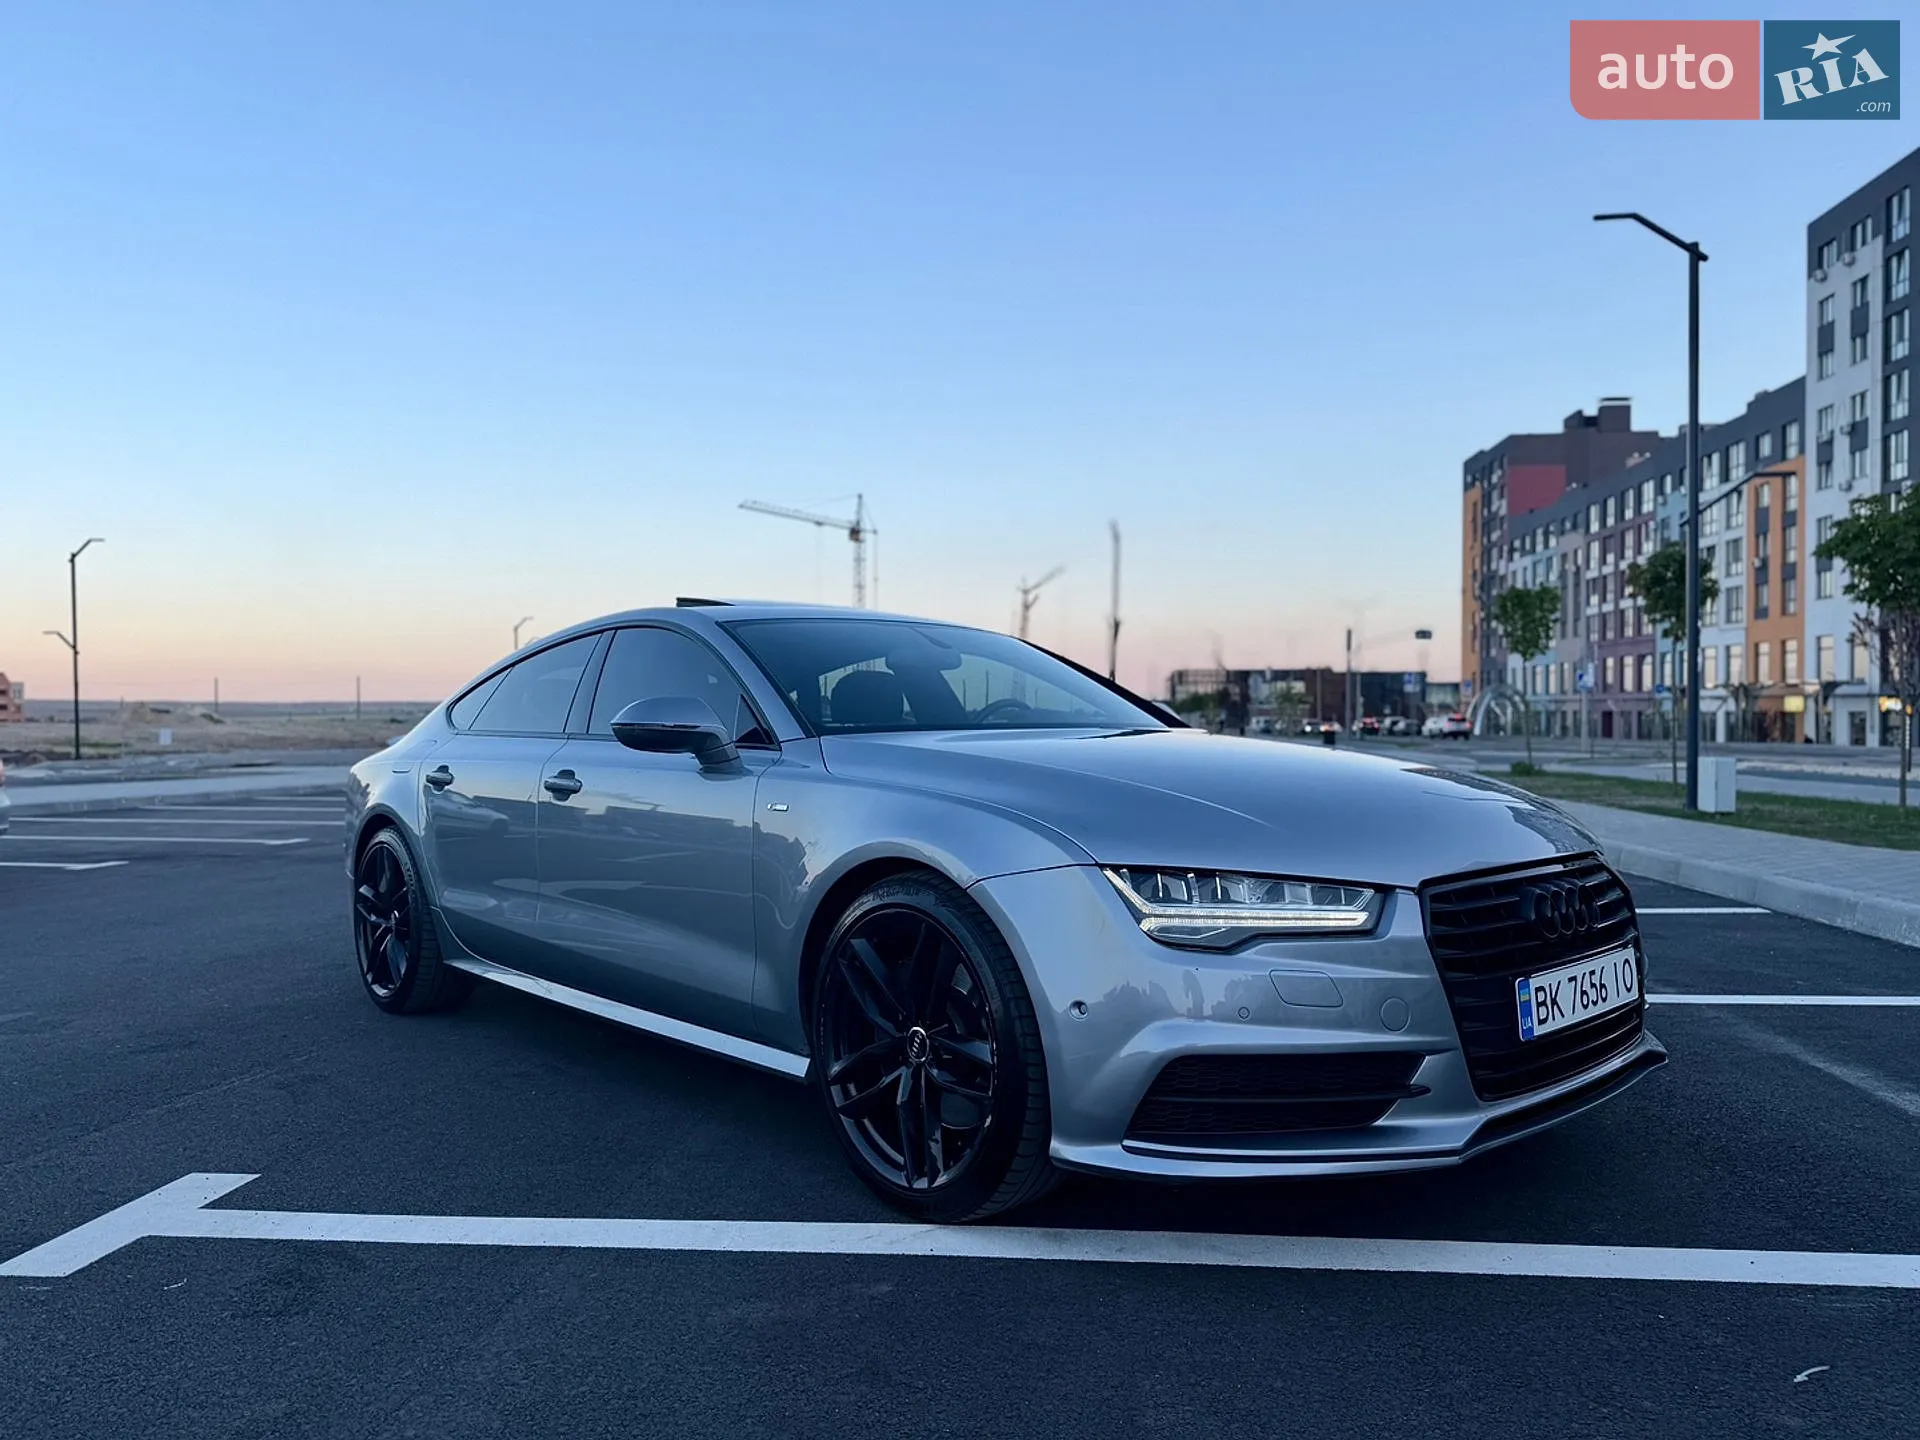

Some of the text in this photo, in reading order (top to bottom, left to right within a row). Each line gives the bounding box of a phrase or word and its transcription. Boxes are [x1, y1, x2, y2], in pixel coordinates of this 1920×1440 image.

[1534, 980, 1565, 1026] BK
[1568, 967, 1608, 1015] 7656
[1522, 1017, 1533, 1029] UA
